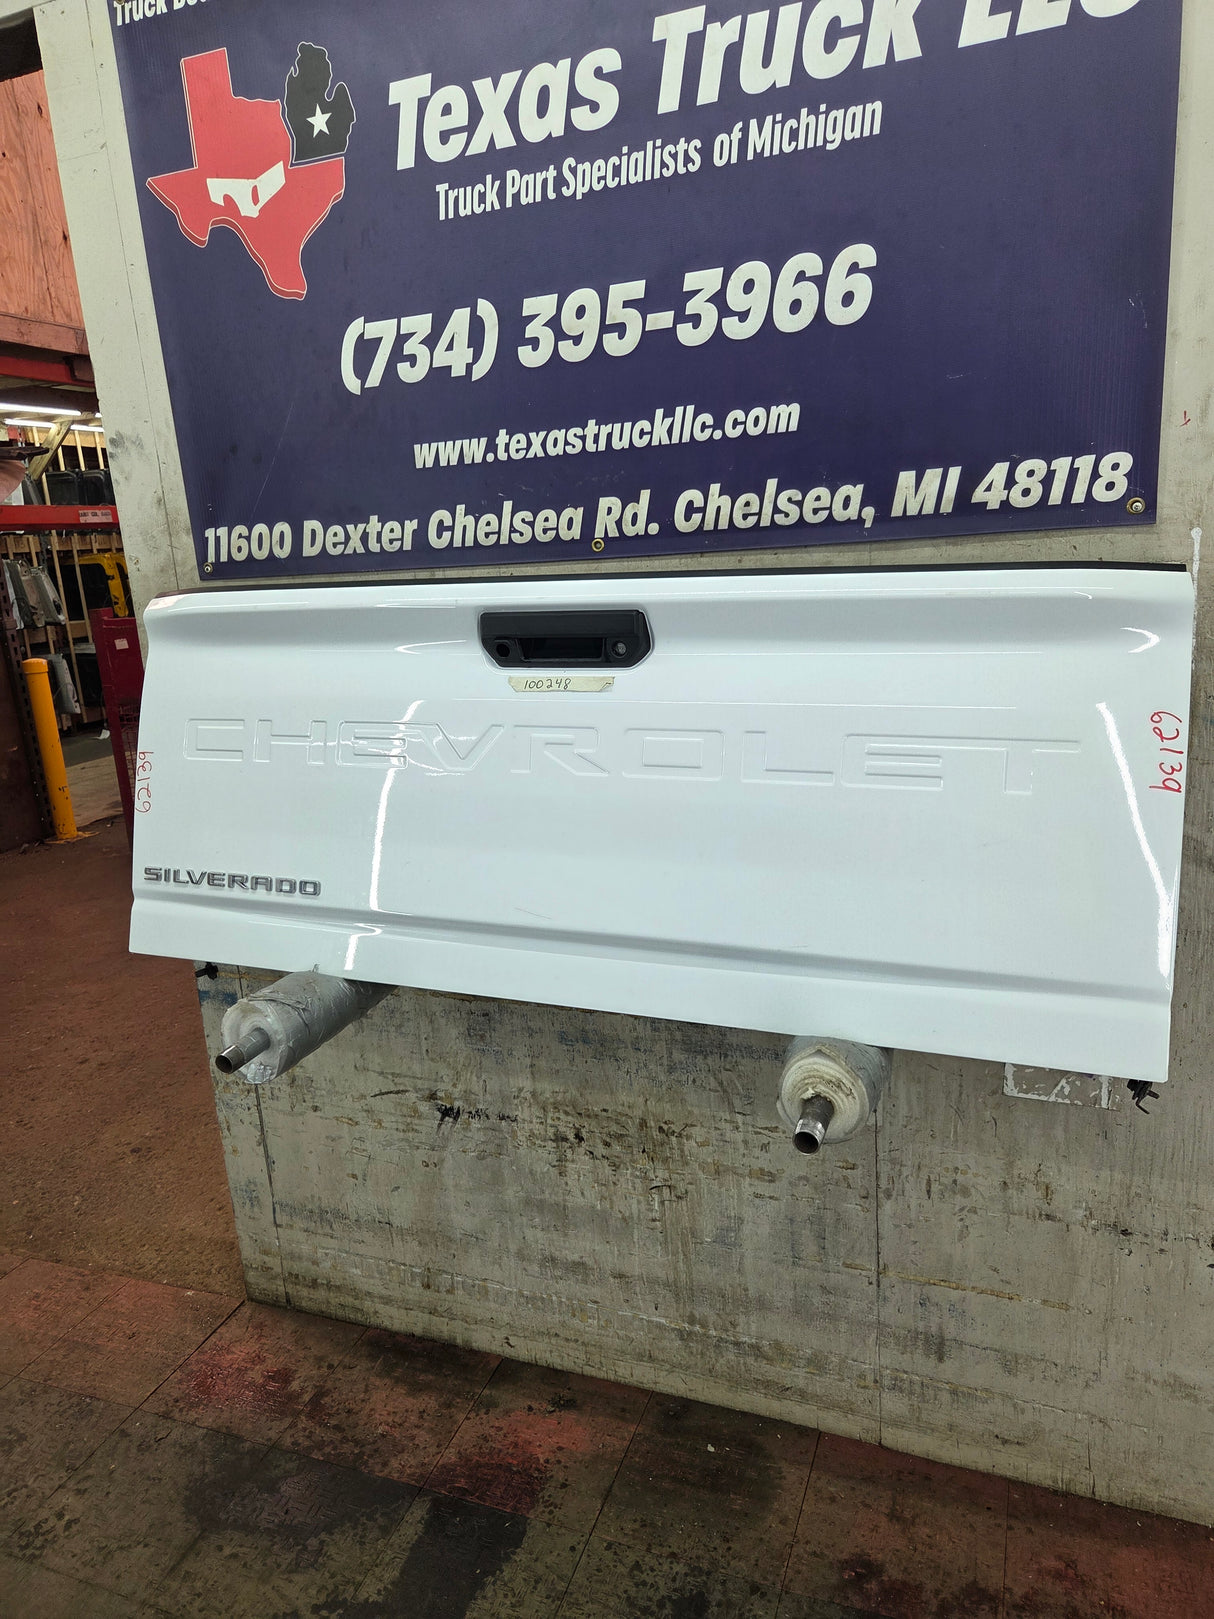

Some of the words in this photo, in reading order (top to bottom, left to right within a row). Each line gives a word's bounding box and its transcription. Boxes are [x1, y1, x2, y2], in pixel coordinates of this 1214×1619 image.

[113, 0, 168, 26] Truck
[388, 48, 623, 171] Texas
[651, 0, 923, 115] Truck
[435, 174, 501, 221] Truck
[505, 163, 558, 209] Part
[561, 136, 702, 201] Specialists
[712, 121, 743, 167] of
[746, 100, 883, 161] Michigan
[340, 298, 499, 396] (734)
[517, 243, 878, 368] 395-3966
[413, 402, 801, 469] www.texastruckllc.com
[204, 521, 292, 563] 11600
[302, 514, 419, 557] Dexter
[427, 500, 584, 549] Chelsea
[594, 488, 660, 539] Rd.
[673, 477, 875, 533] Chelsea,
[890, 465, 962, 518] MI
[970, 451, 1134, 510] 48118
[523, 678, 572, 690] 100248
[182, 718, 1081, 797] CHEVROLET
[144, 866, 321, 897] SILVERADO
